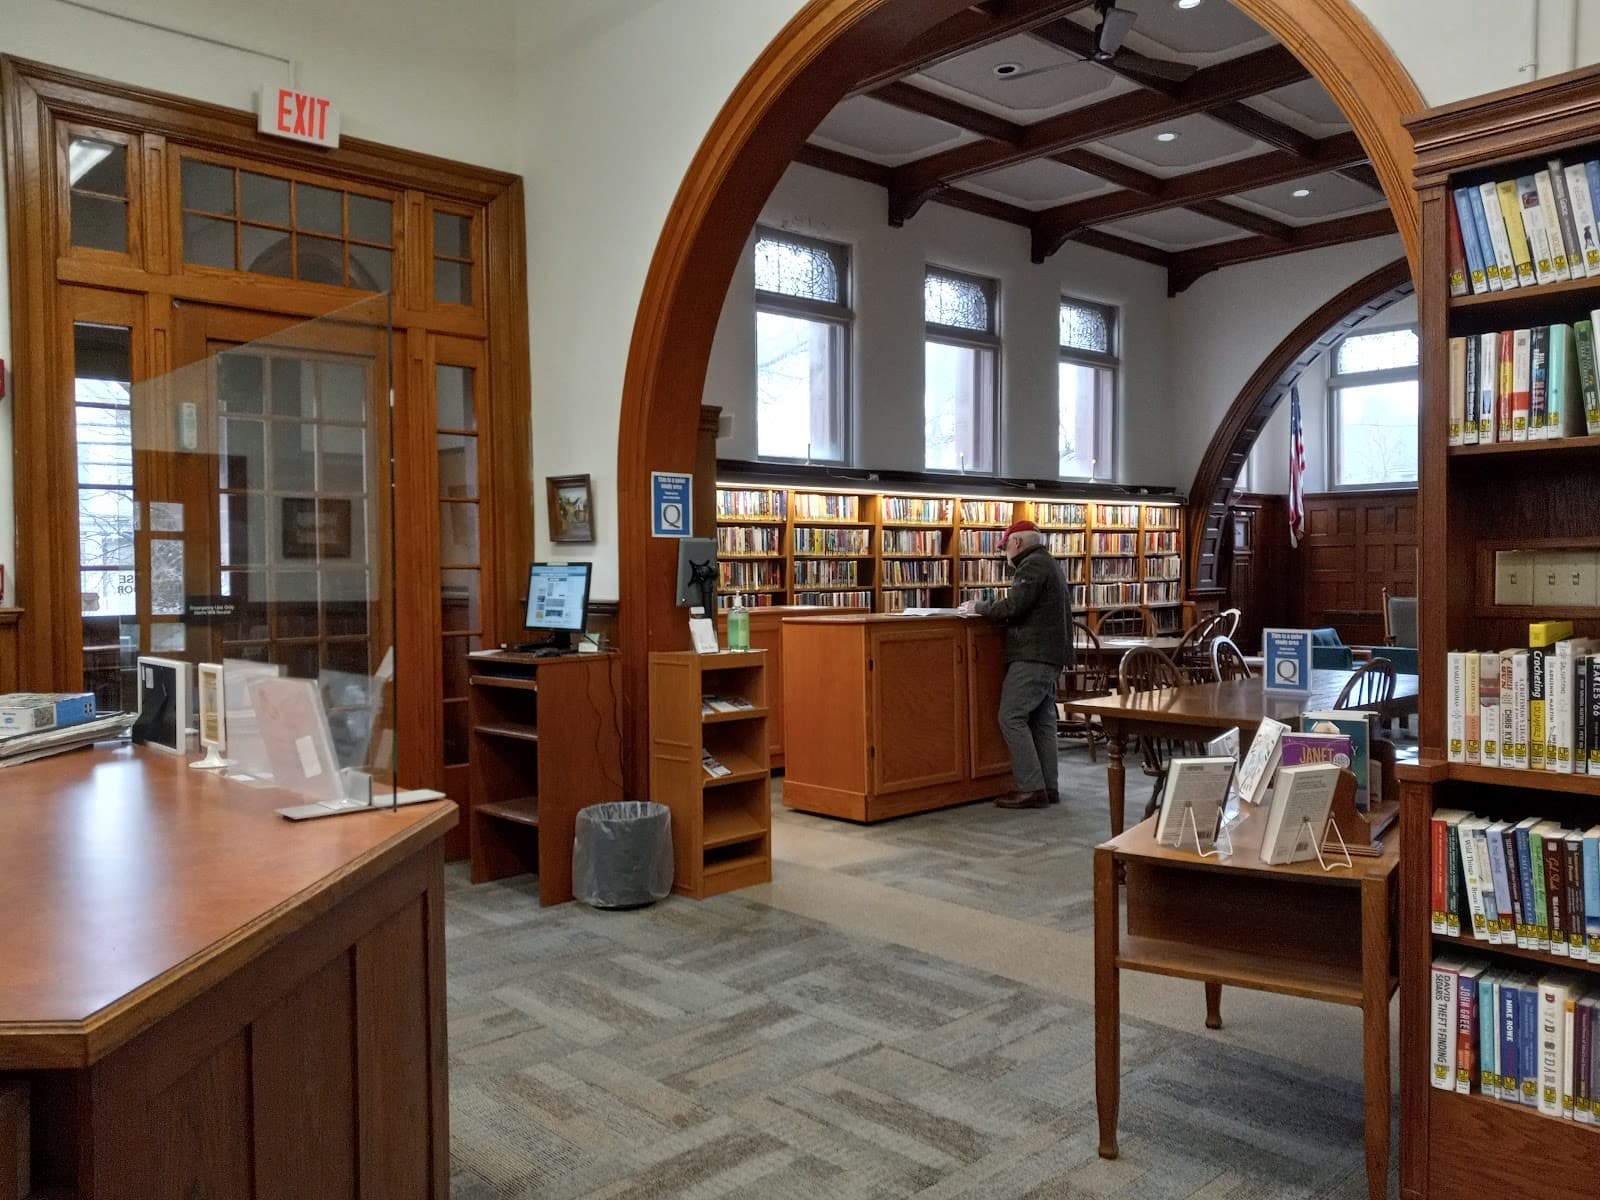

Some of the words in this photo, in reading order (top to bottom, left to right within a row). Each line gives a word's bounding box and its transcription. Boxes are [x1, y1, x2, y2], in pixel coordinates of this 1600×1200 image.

[278, 89, 330, 140] EXIT
[663, 504, 681, 528] Q
[1277, 660, 1297, 683] Q
[1532, 650, 1543, 698] Crocheting
[1504, 709, 1513, 729] CHRIS
[1300, 747, 1335, 764] JANET
[1465, 839, 1473, 855] Wild
[1467, 855, 1475, 876] Things
[1436, 974, 1444, 1001] SEDARIS
[1460, 986, 1471, 1008] JOHN
[1438, 1003, 1447, 1028] THEFT
[1505, 1000, 1513, 1019] MIKE
[1460, 1009, 1470, 1035] GREEN
[1506, 1021, 1514, 1043] ROWE
[1437, 1032, 1447, 1063] FINDING
